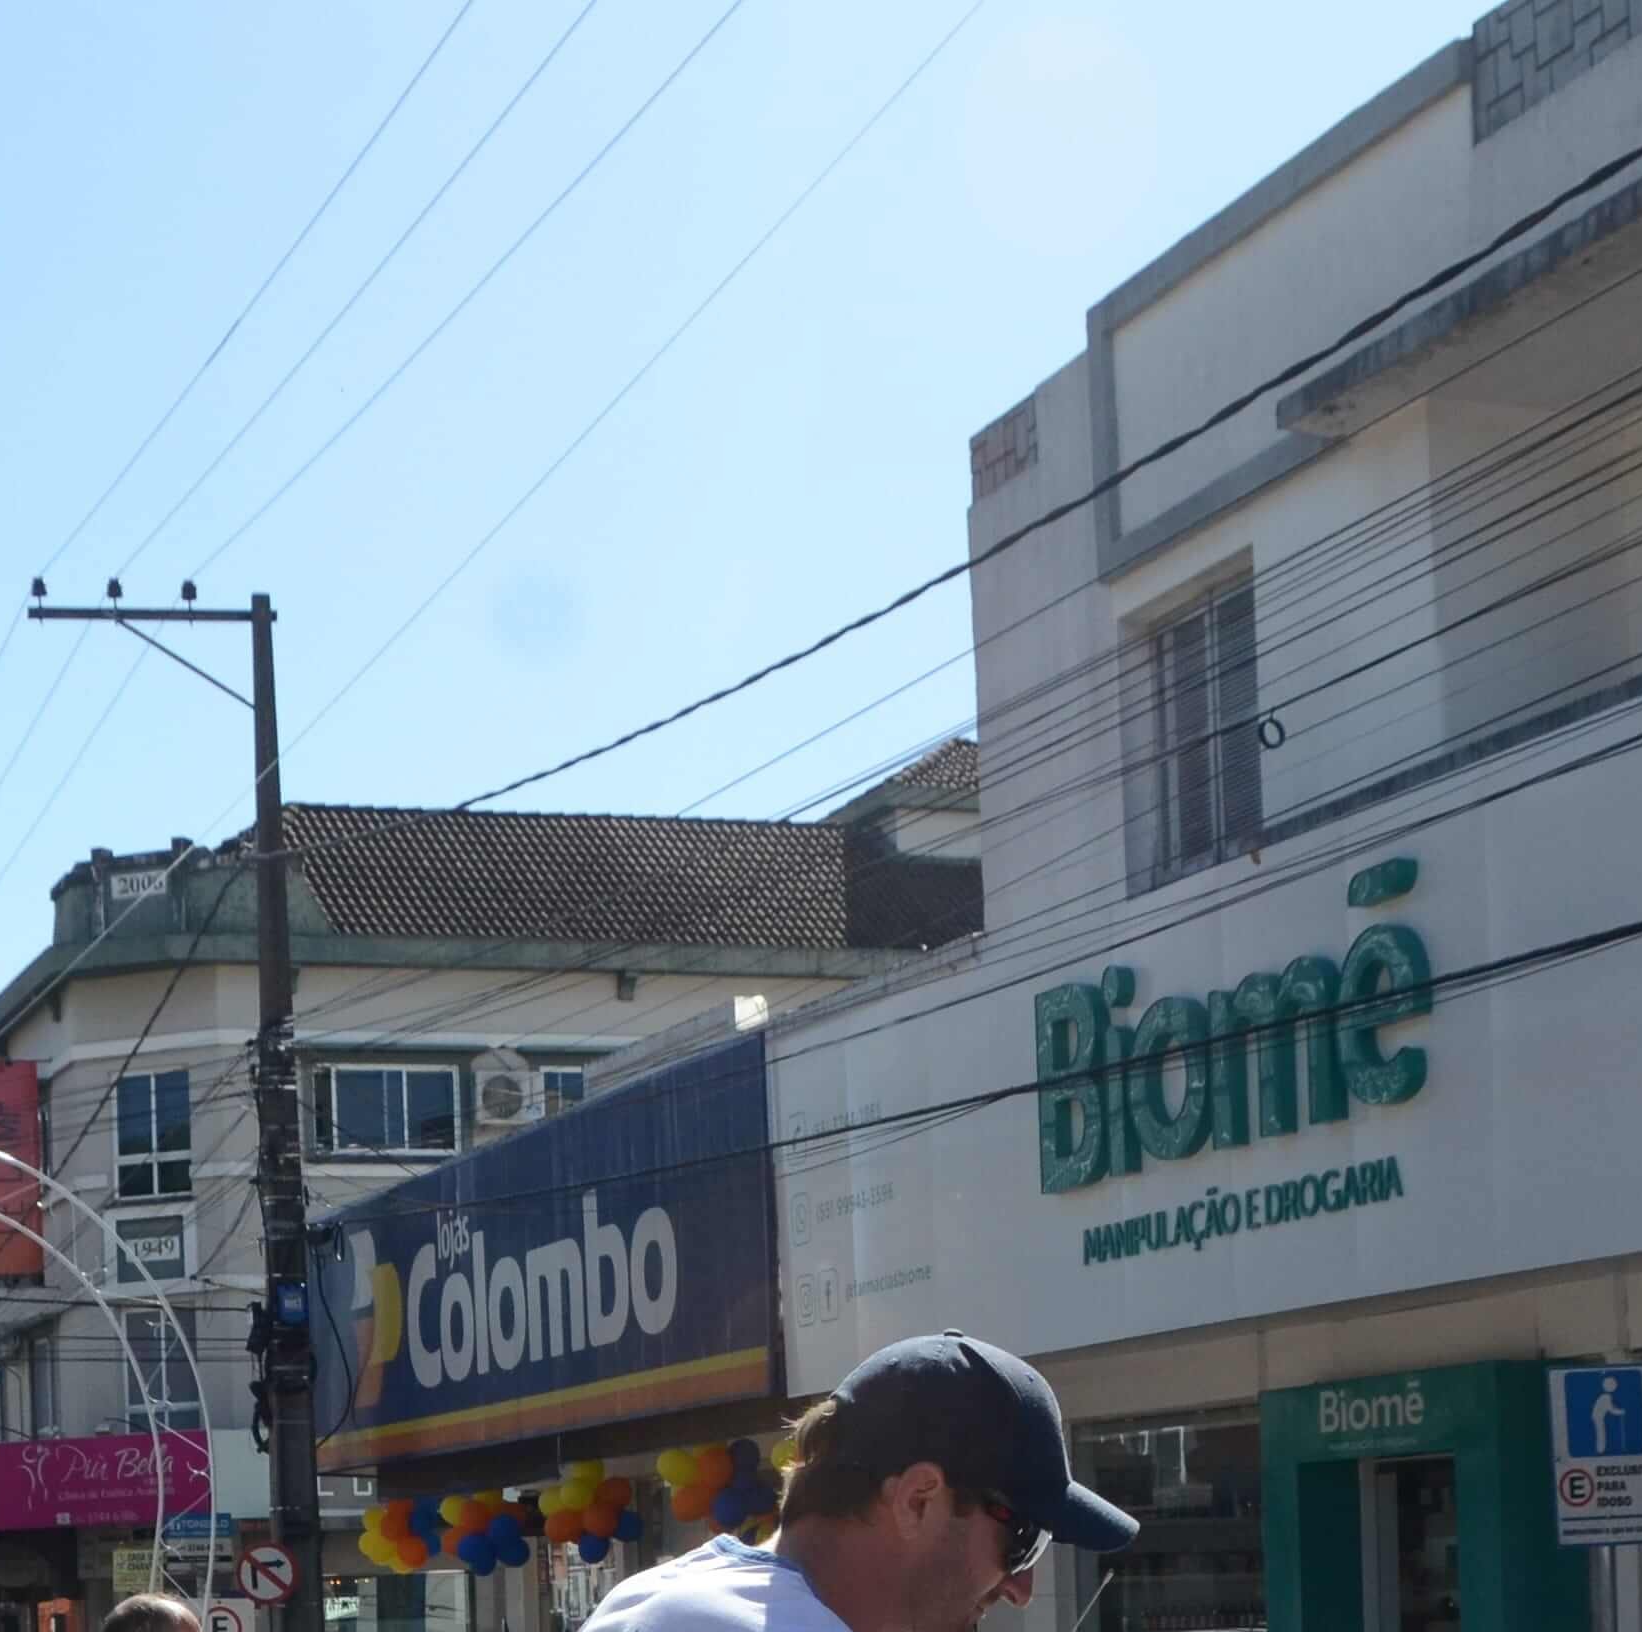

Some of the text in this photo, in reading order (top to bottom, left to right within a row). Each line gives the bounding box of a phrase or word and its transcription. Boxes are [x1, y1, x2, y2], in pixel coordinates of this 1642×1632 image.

[1034, 856, 1434, 1195] Biomē
[1083, 1156, 1404, 1266] MANIPULAÇÃO E DROGARIA
[437, 1210, 469, 1269] lojas
[407, 1188, 677, 1388] Colombo
[1319, 1381, 1424, 1433] Biomē
[1569, 1476, 1586, 1499] E
[1597, 1481, 1627, 1491] PARA
[1597, 1496, 1632, 1507] IDOSO
